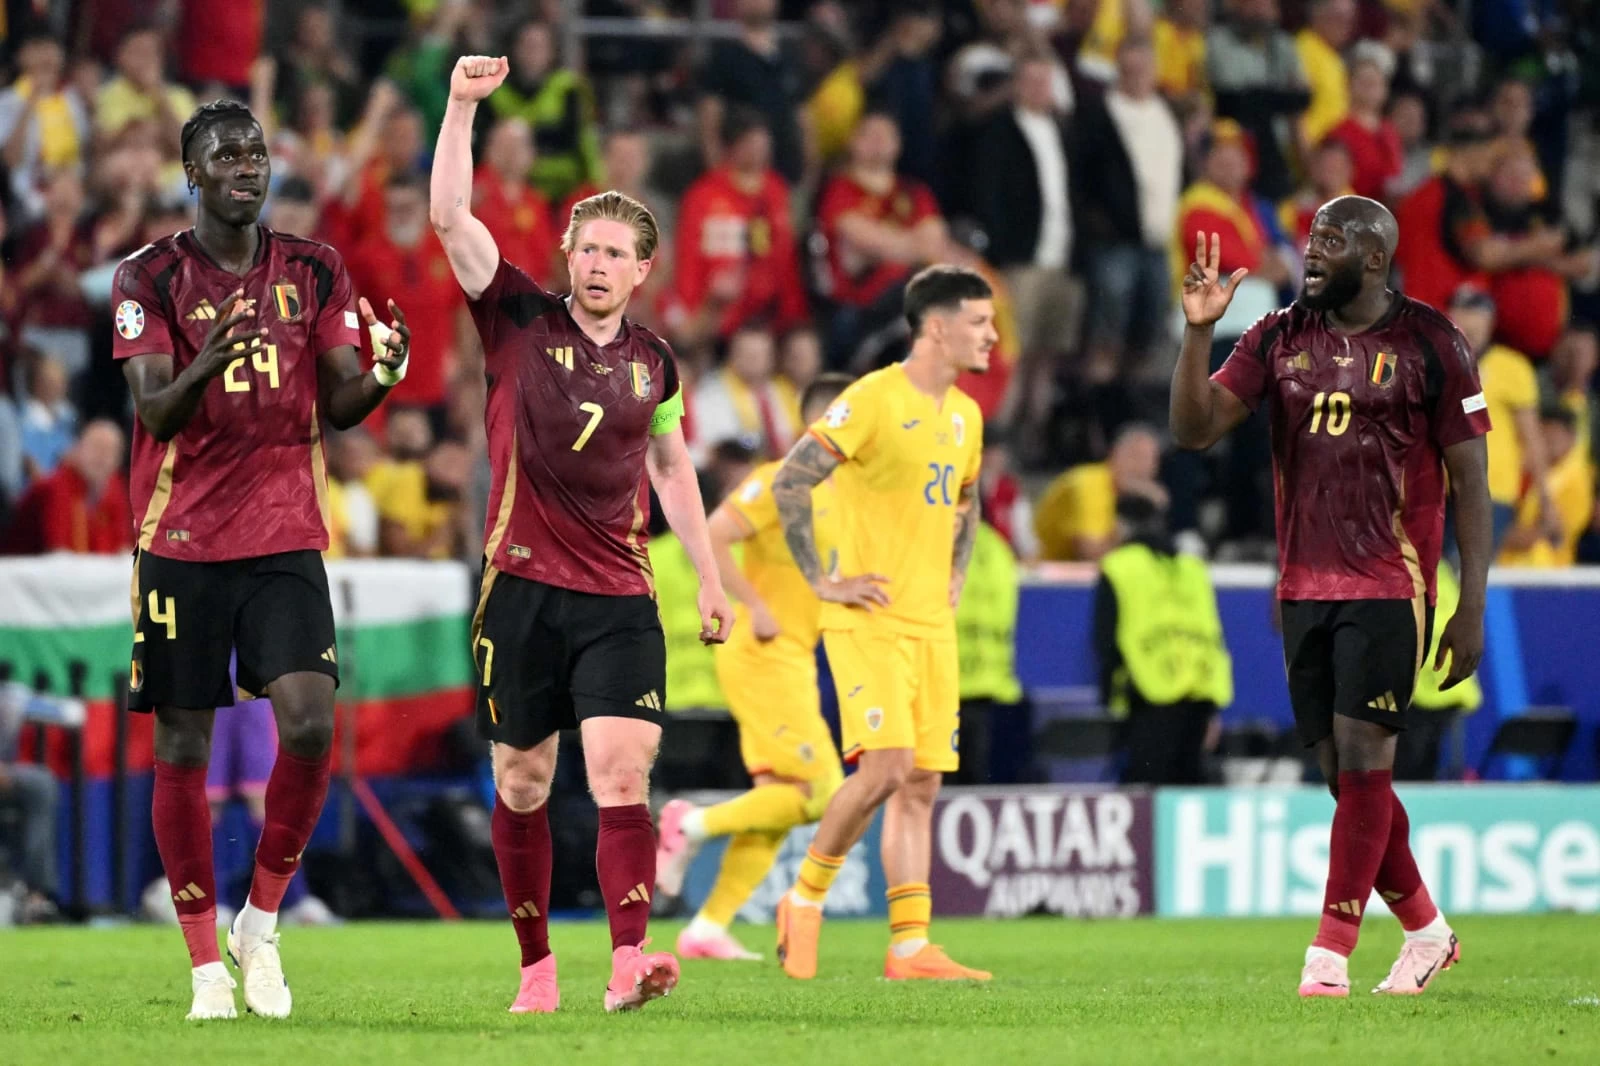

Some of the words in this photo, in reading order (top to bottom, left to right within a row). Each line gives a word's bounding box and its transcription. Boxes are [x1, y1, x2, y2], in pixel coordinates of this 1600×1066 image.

[224, 337, 280, 393] 24
[571, 401, 604, 452] 7
[1309, 391, 1352, 436] 10
[923, 462, 955, 506] 20
[134, 588, 177, 643] 4
[479, 637, 494, 687] 7
[938, 793, 1138, 888] QATAR
[1174, 798, 1600, 915] Hisnse
